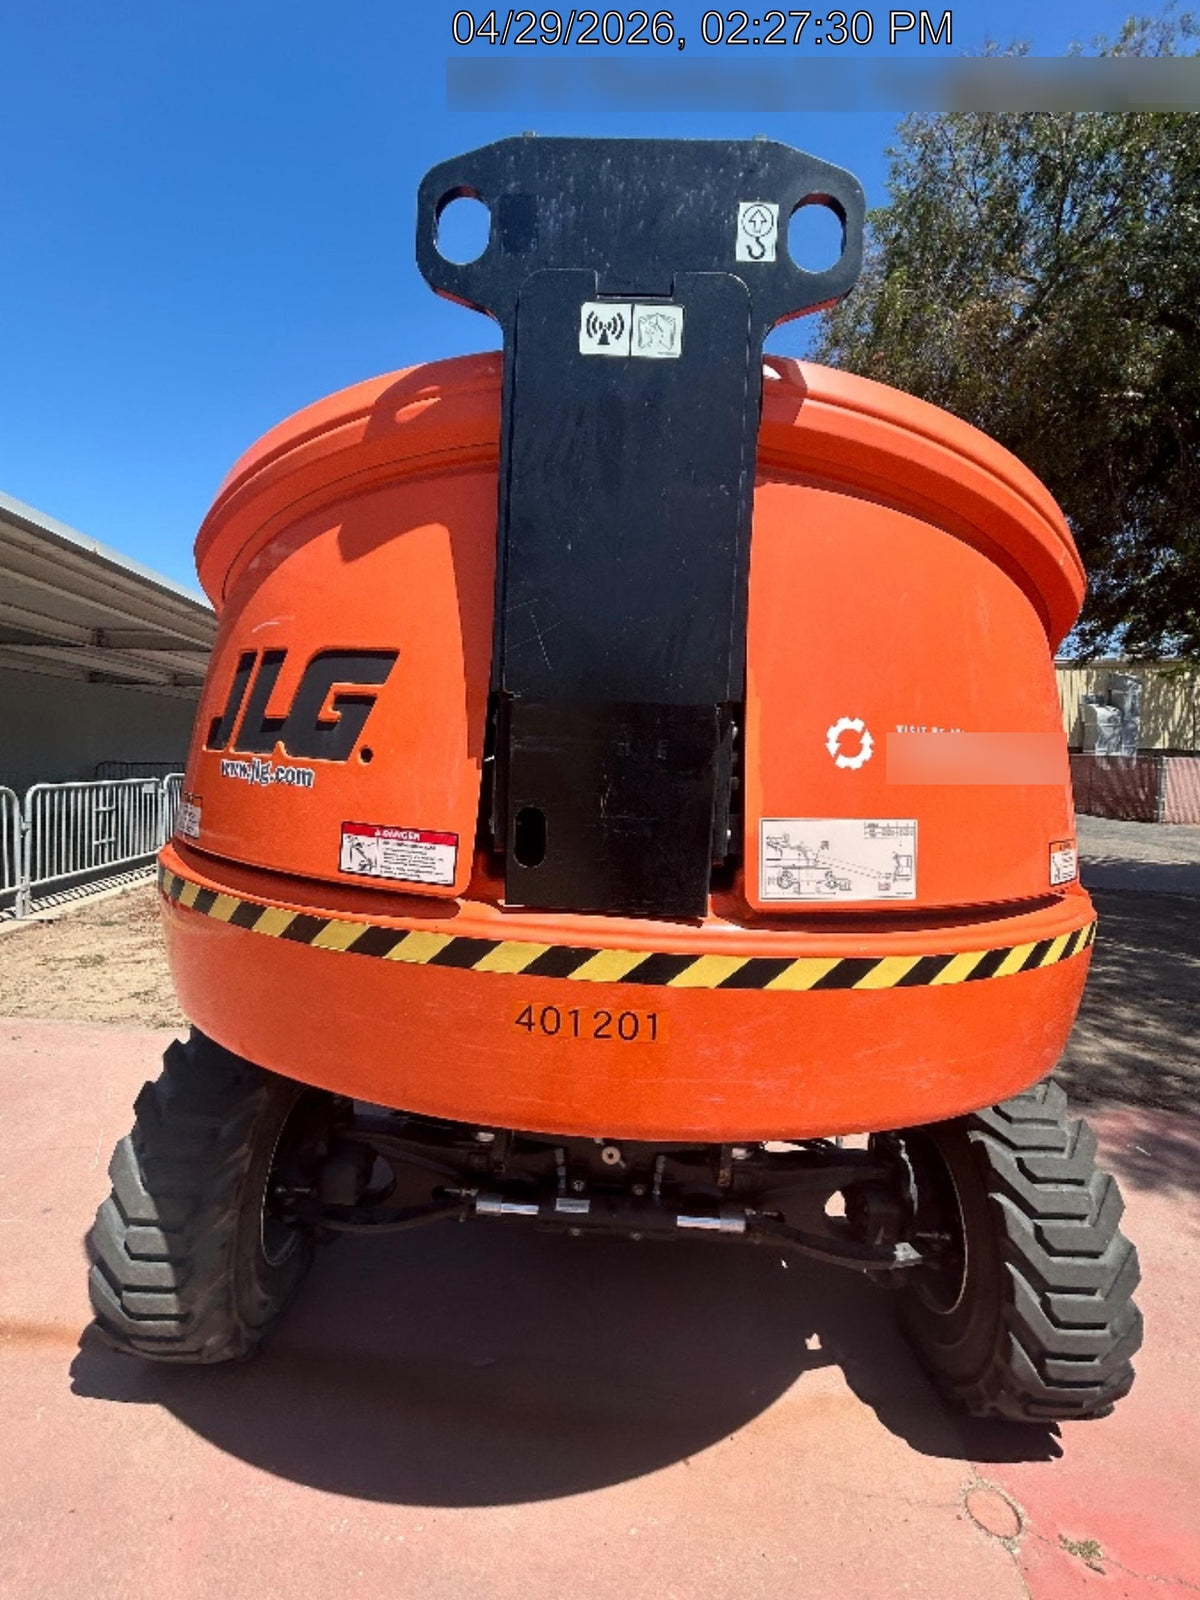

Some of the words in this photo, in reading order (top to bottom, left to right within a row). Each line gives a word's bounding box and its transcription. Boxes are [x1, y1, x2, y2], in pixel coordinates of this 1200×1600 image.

[206, 648, 400, 761] JLG
[220, 758, 314, 787] www.jlg.com
[514, 1004, 657, 1041] 401201
